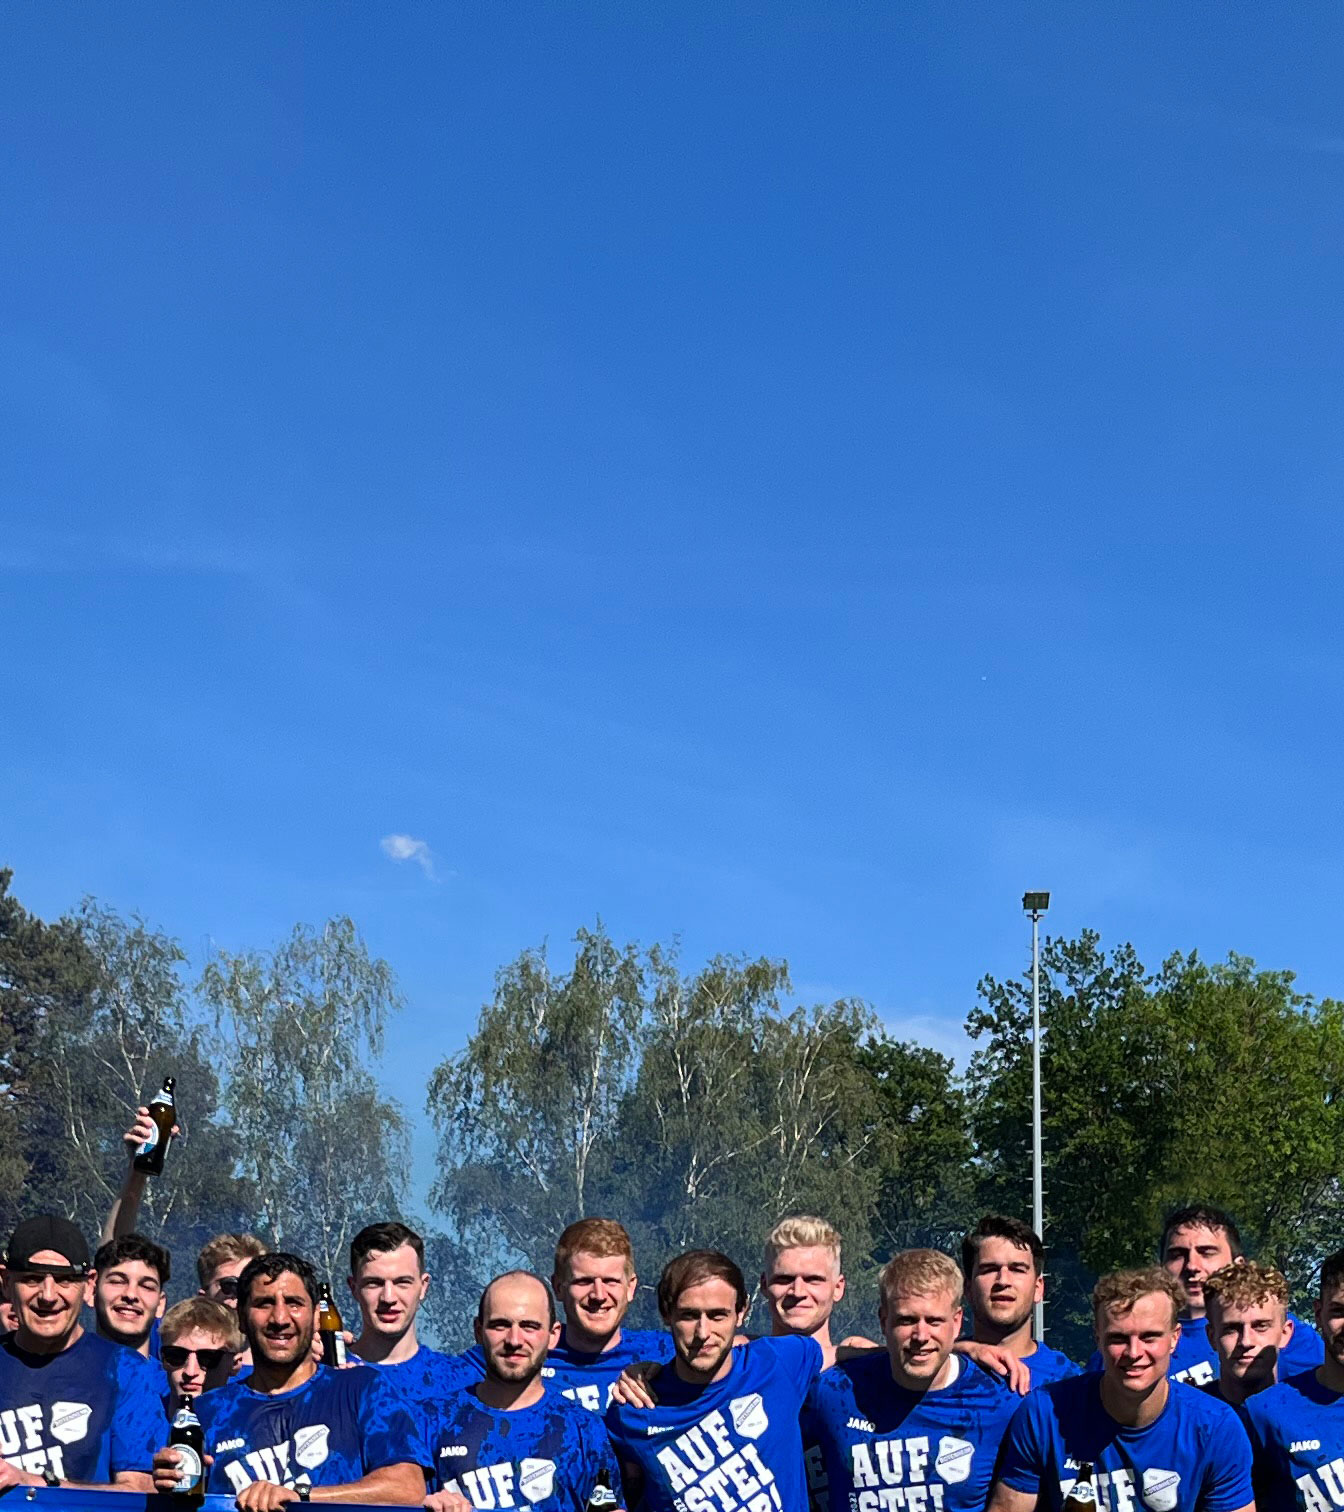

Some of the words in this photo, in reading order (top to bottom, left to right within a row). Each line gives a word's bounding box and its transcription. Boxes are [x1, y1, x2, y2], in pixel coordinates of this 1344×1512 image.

[846, 1417, 876, 1433] JAKO
[215, 1437, 246, 1453] JAKO
[440, 1445, 469, 1458] JAKO
[656, 1409, 735, 1493] AUF
[1289, 1439, 1321, 1453] JAKO
[851, 1435, 930, 1488] AUF
